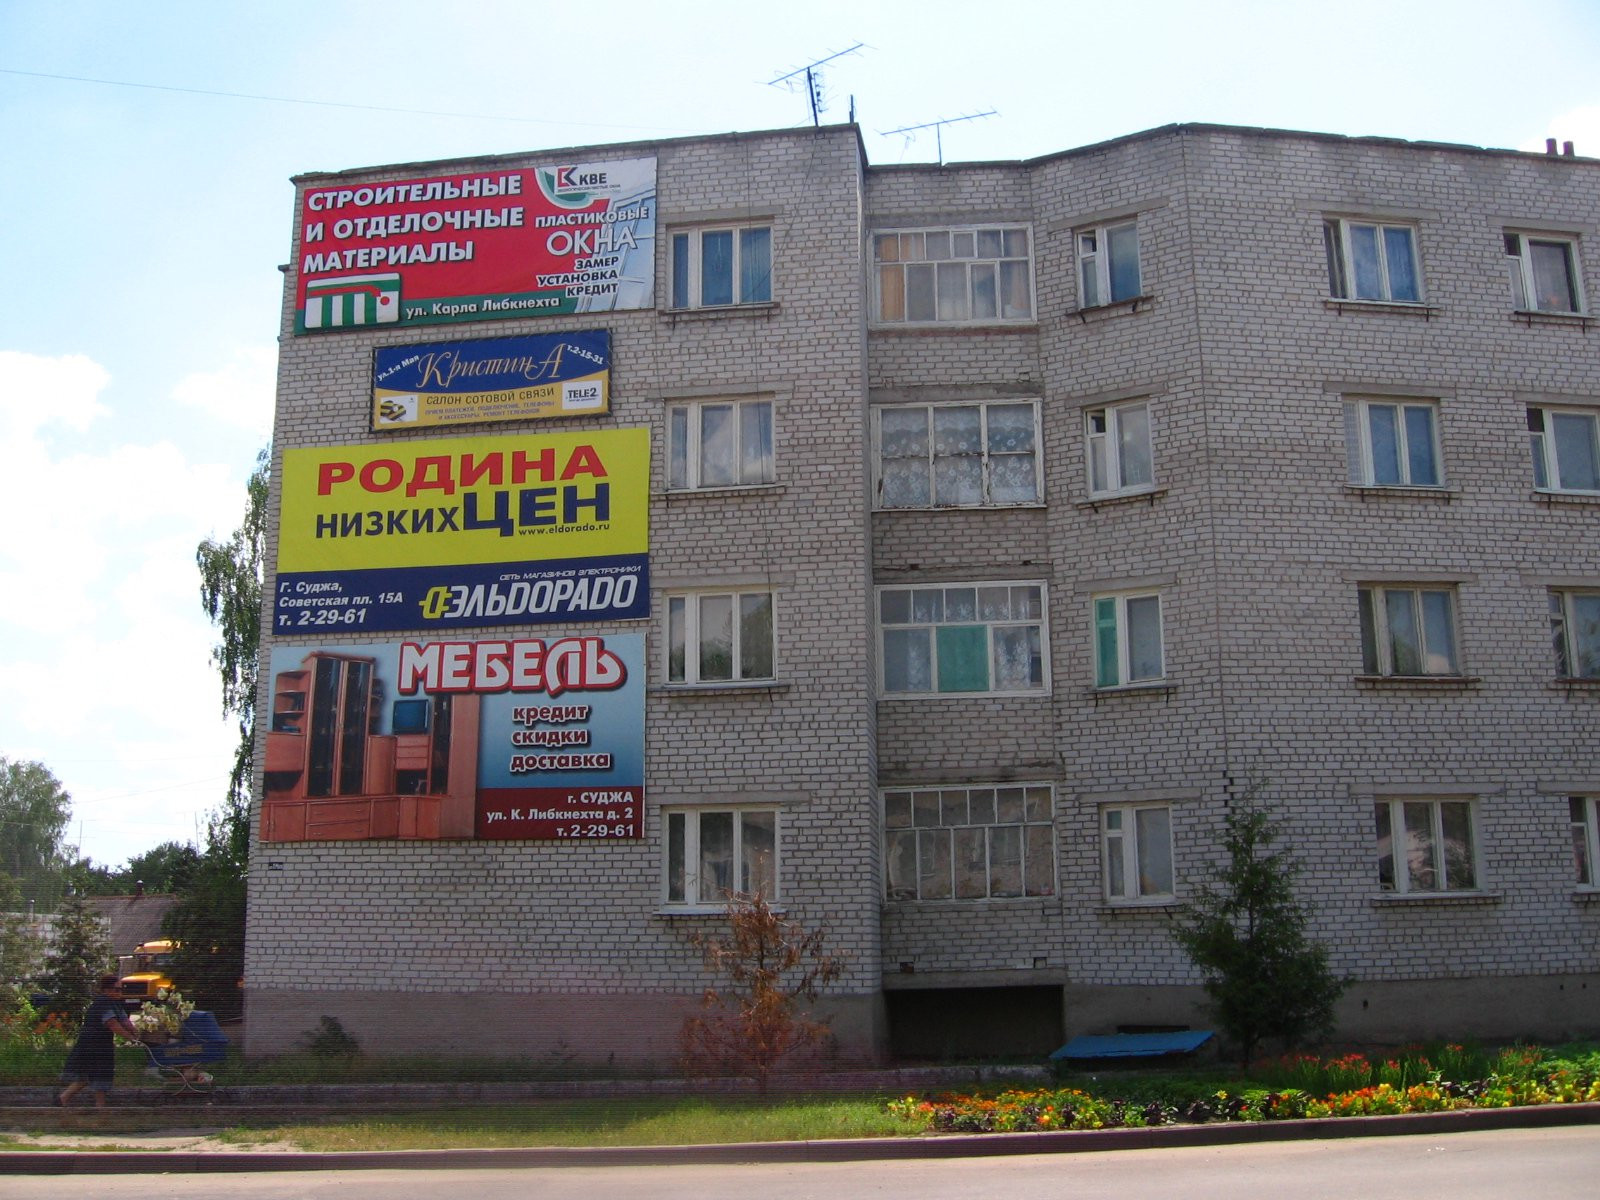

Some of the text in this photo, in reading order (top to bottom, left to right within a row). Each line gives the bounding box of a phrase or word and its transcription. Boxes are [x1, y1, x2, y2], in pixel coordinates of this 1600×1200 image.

[308, 175, 522, 211] СТРОИТЕЛЬНЫЕ
[305, 206, 524, 243] И ОТДЕЛОЧНЫЕ
[535, 206, 649, 228] ПЛАСТИКОВЫЕ
[546, 226, 638, 256] ОКНА
[303, 241, 474, 274] МАТЕРИАЛЫ
[575, 256, 619, 270] ЗАМЕР
[536, 269, 619, 287] УСТАНОВКА
[566, 282, 619, 298] КРЕДИТ
[406, 295, 560, 320] ул. Карла Либкнехта
[465, 391, 515, 404] сотовой
[519, 387, 554, 400] связи
[567, 387, 598, 399] TELE2
[317, 445, 608, 497] РОДИНА
[315, 482, 610, 538] НИЗКИХ ЦЕН
[518, 523, 610, 536] www.eldorado.ru
[500, 565, 641, 581] СЕТЬ МАГАЗИНОВ ЭЛЕКТРОНИКИ
[279, 580, 343, 596] Г. Суджа,
[279, 595, 349, 608] Советская
[353, 594, 373, 605] пл.
[297, 608, 367, 626] 2-29-61
[398, 637, 627, 695] МЕБЕЛЬ
[513, 705, 589, 725] кредит
[512, 729, 588, 747] скидки
[510, 753, 611, 772] доставка
[567, 791, 634, 804] г. СУДЖА
[487, 807, 634, 822] ул. К. Либкнехта д. 2
